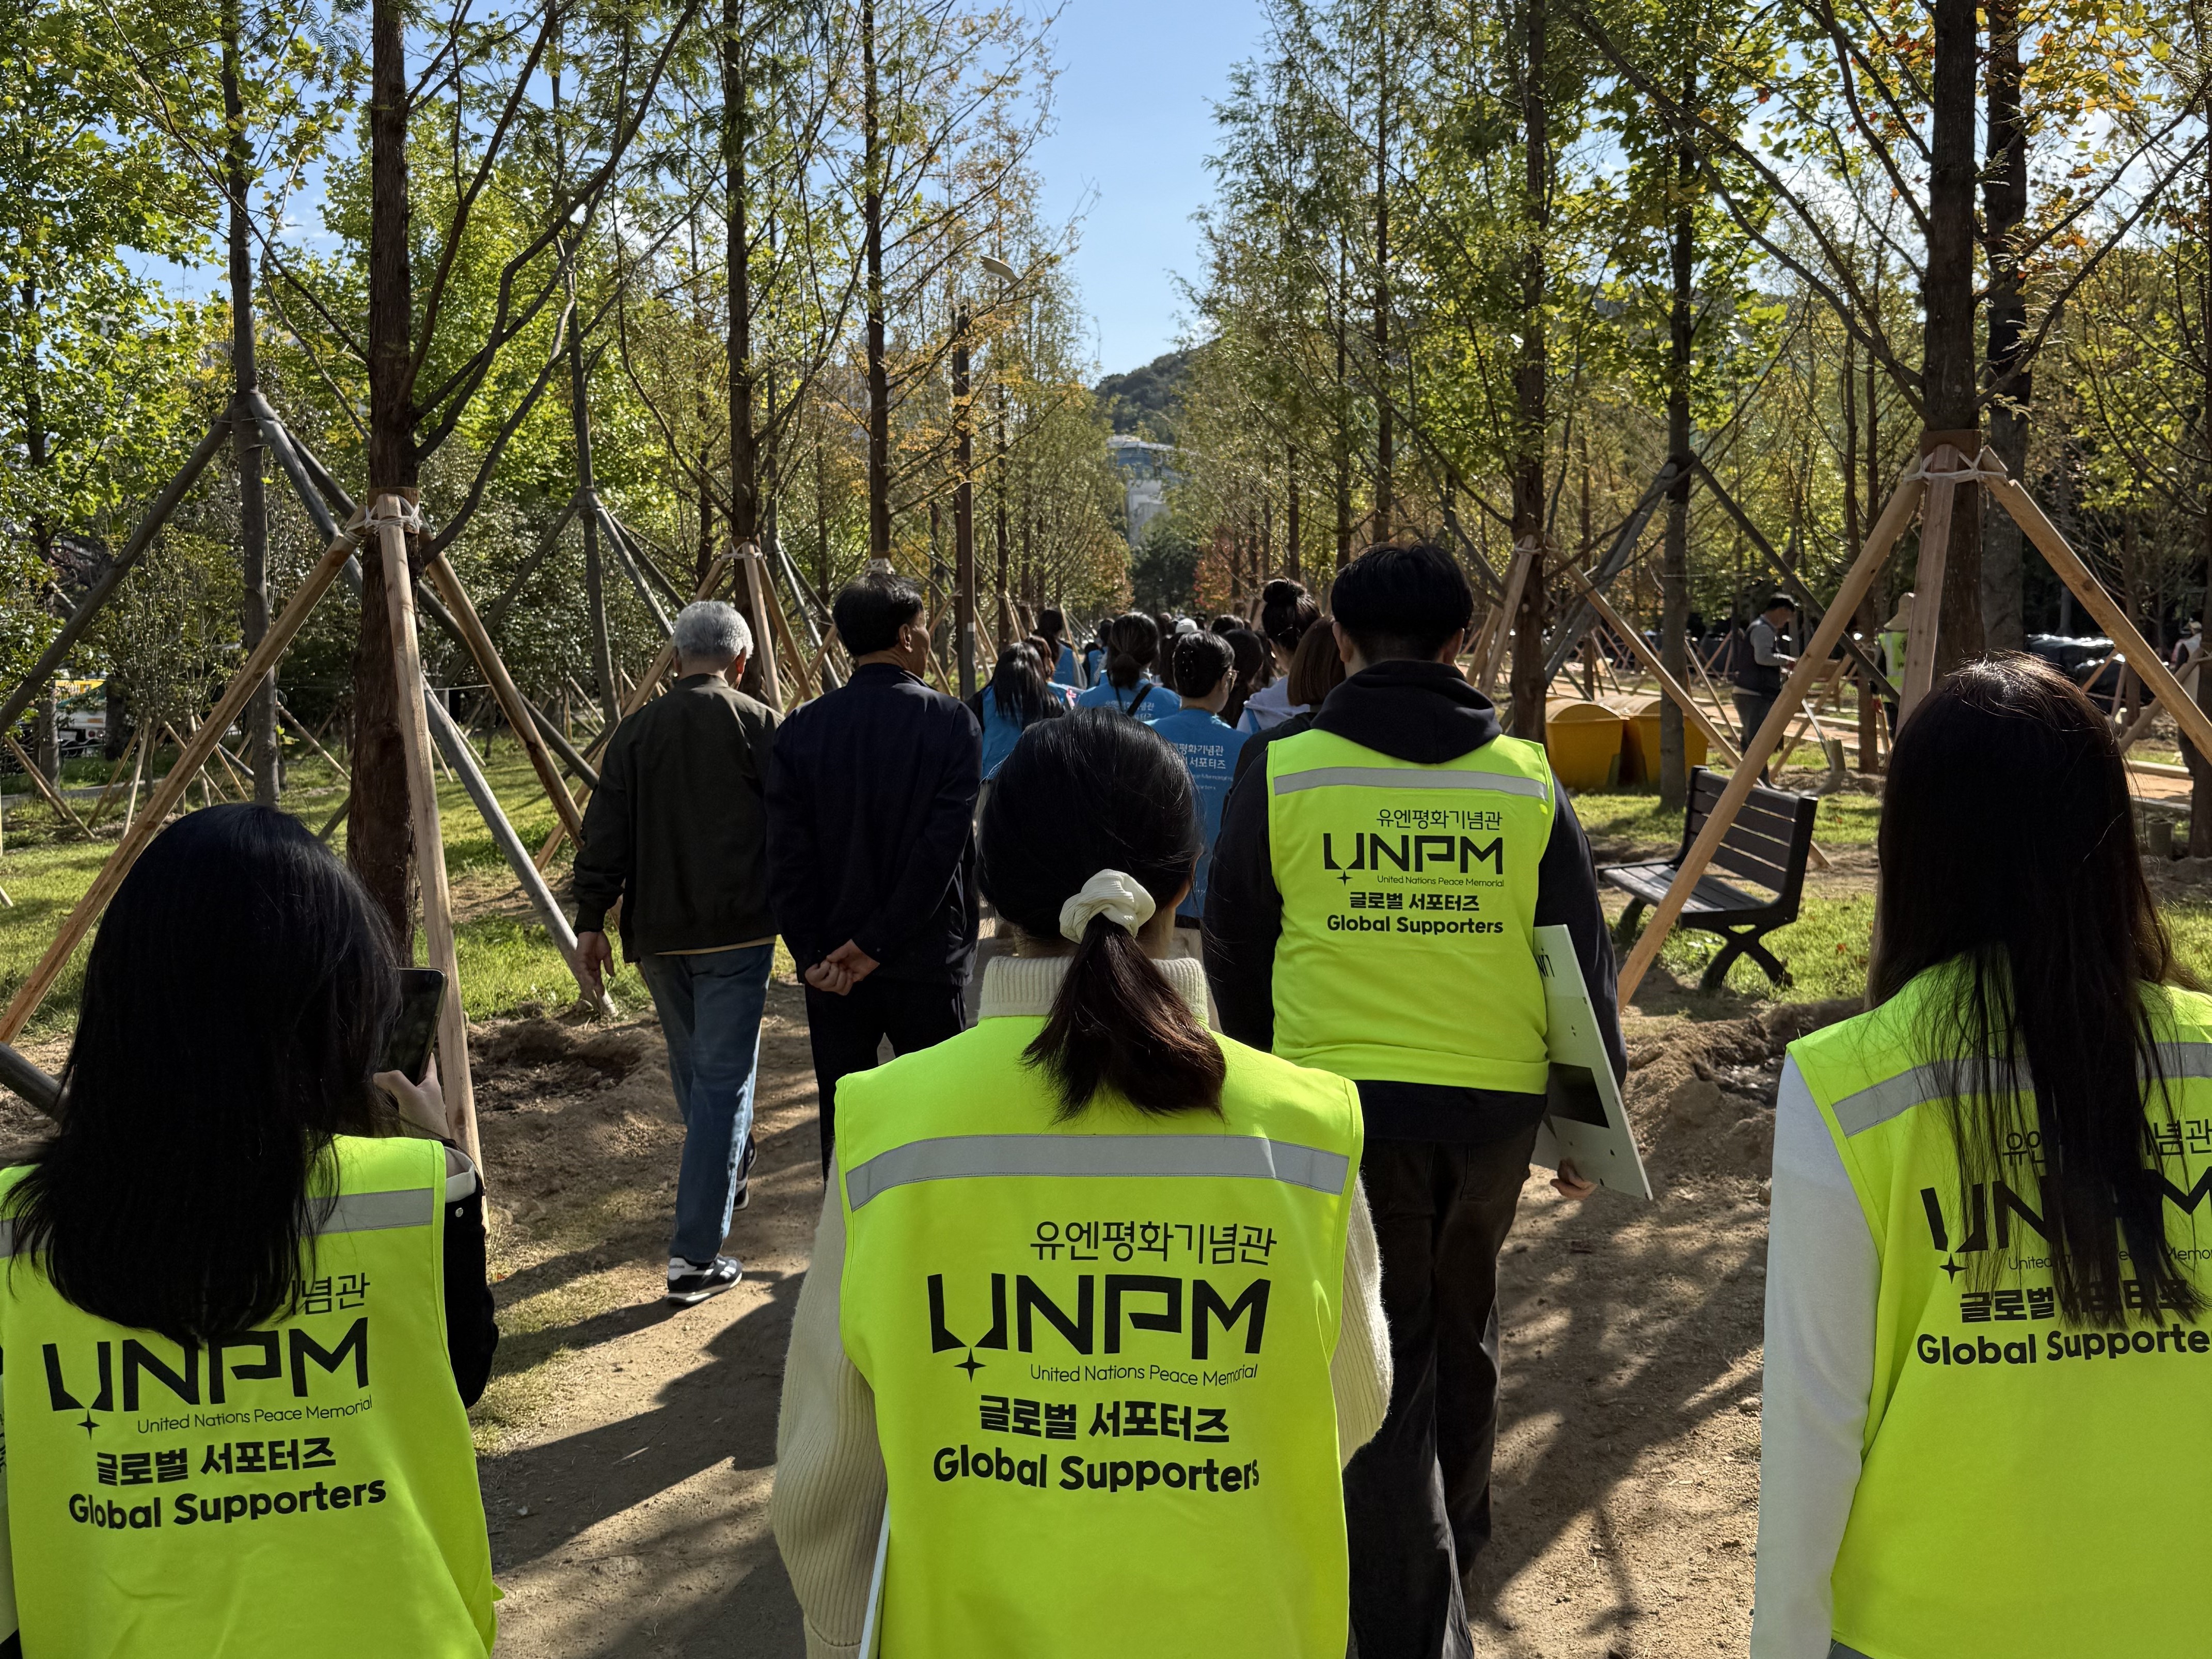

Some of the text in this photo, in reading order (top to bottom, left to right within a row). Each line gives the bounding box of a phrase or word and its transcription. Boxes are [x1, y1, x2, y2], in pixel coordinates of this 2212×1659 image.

[1175, 743, 1224, 756] 평화기념관
[1377, 809, 1503, 831] 유엔평화기념관
[1323, 833, 1503, 875] UNPM
[1350, 892, 1480, 911] 글로벌 서포터즈
[1377, 875, 1504, 887] United Nations Peace Memorial
[1327, 914, 1504, 936] Global Supporters
[1920, 1166, 2212, 1253] UNM
[1030, 1221, 1277, 1266] 유엔평화기념관
[927, 1273, 1271, 1360] UNPM
[1960, 1286, 2055, 1323] 글로벌
[42, 1317, 369, 1412] UNPM
[1917, 1323, 2212, 1366] Global Supporte
[1030, 1363, 1258, 1387] United Nations Peace Memorial
[137, 1394, 373, 1435] United Nations Peace Memorial
[979, 1395, 1229, 1443] 글로벌 서포터즈
[97, 1437, 336, 1487] 글로벌 서포터즈
[934, 1444, 1260, 1493] Global Supporters
[69, 1478, 387, 1529] Global Supporters
